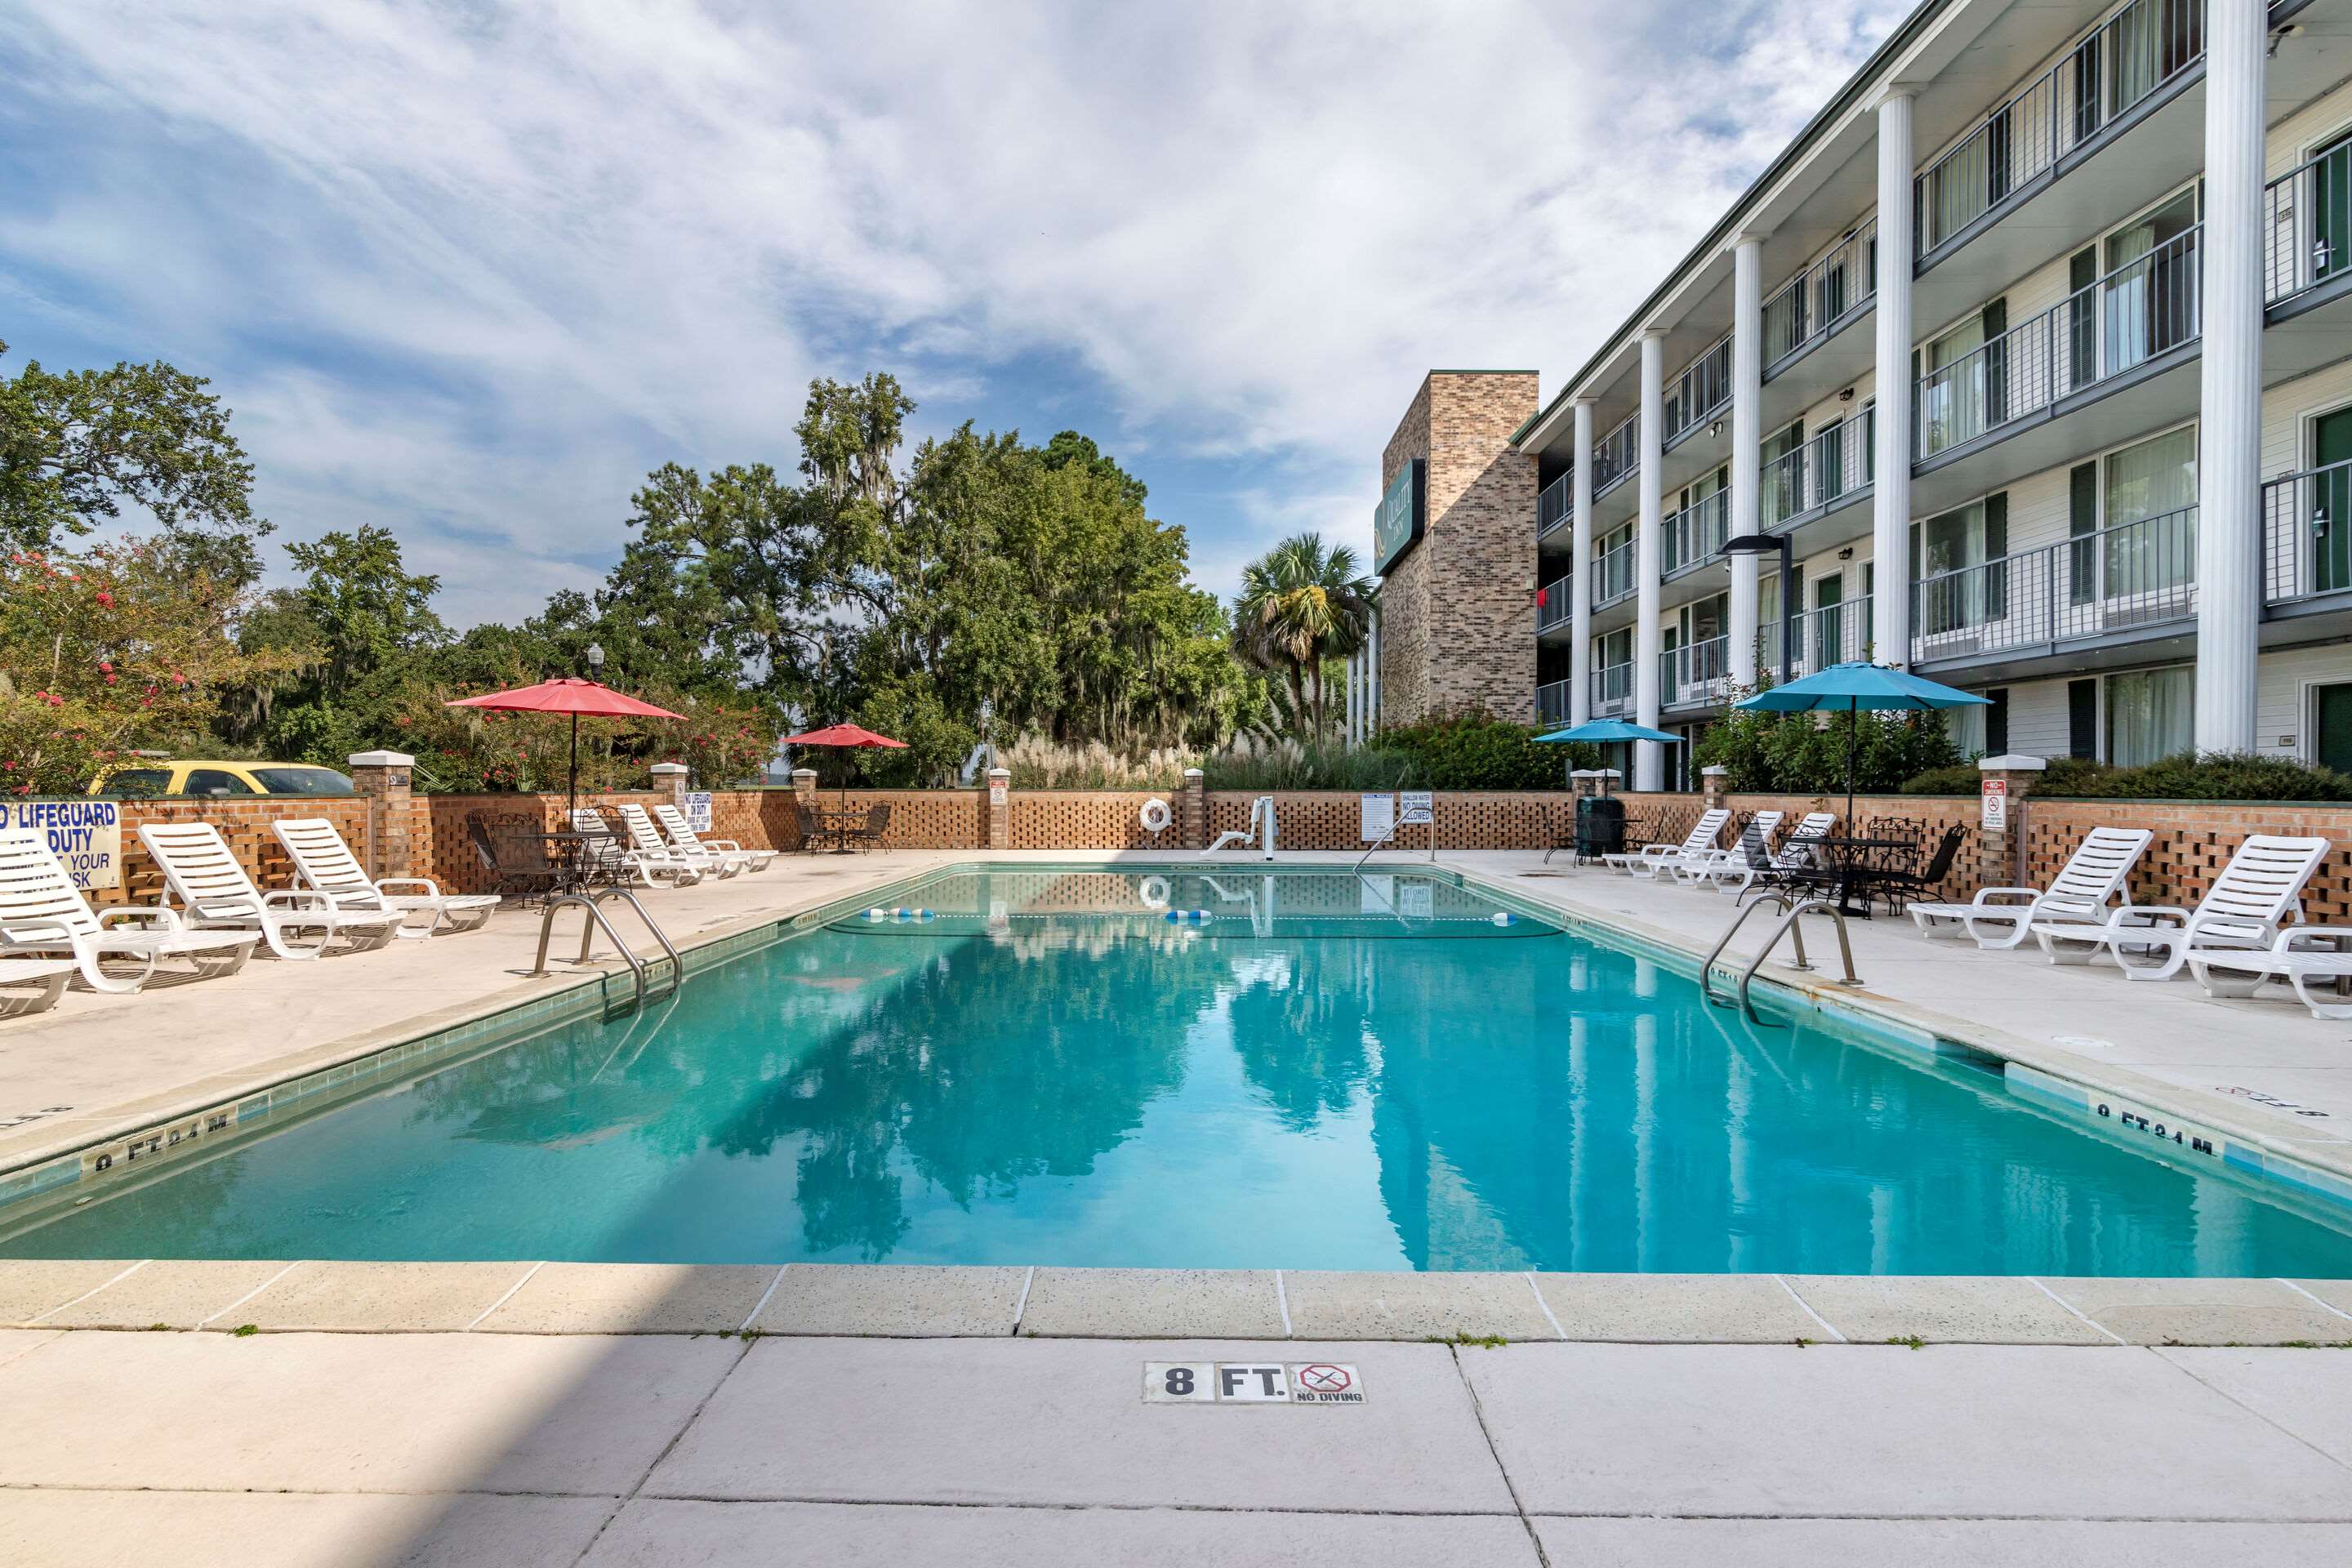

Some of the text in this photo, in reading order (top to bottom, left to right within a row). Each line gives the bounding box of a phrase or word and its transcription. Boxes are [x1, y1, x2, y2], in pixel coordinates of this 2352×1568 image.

[1387, 477, 1411, 530] QUALITY
[1393, 517, 1404, 542] INN
[685, 793, 710, 804] NO LIFEGUARD
[1403, 802, 1410, 810] NO
[0, 803, 116, 830] O LIFEGUARD
[691, 805, 706, 815] ON DUTY
[47, 828, 93, 853] DUTY
[70, 853, 109, 870] YOUR
[69, 871, 91, 889] SK
[1165, 1367, 1285, 1396] 8 FT.
[1297, 1392, 1363, 1402] NO DIVING
